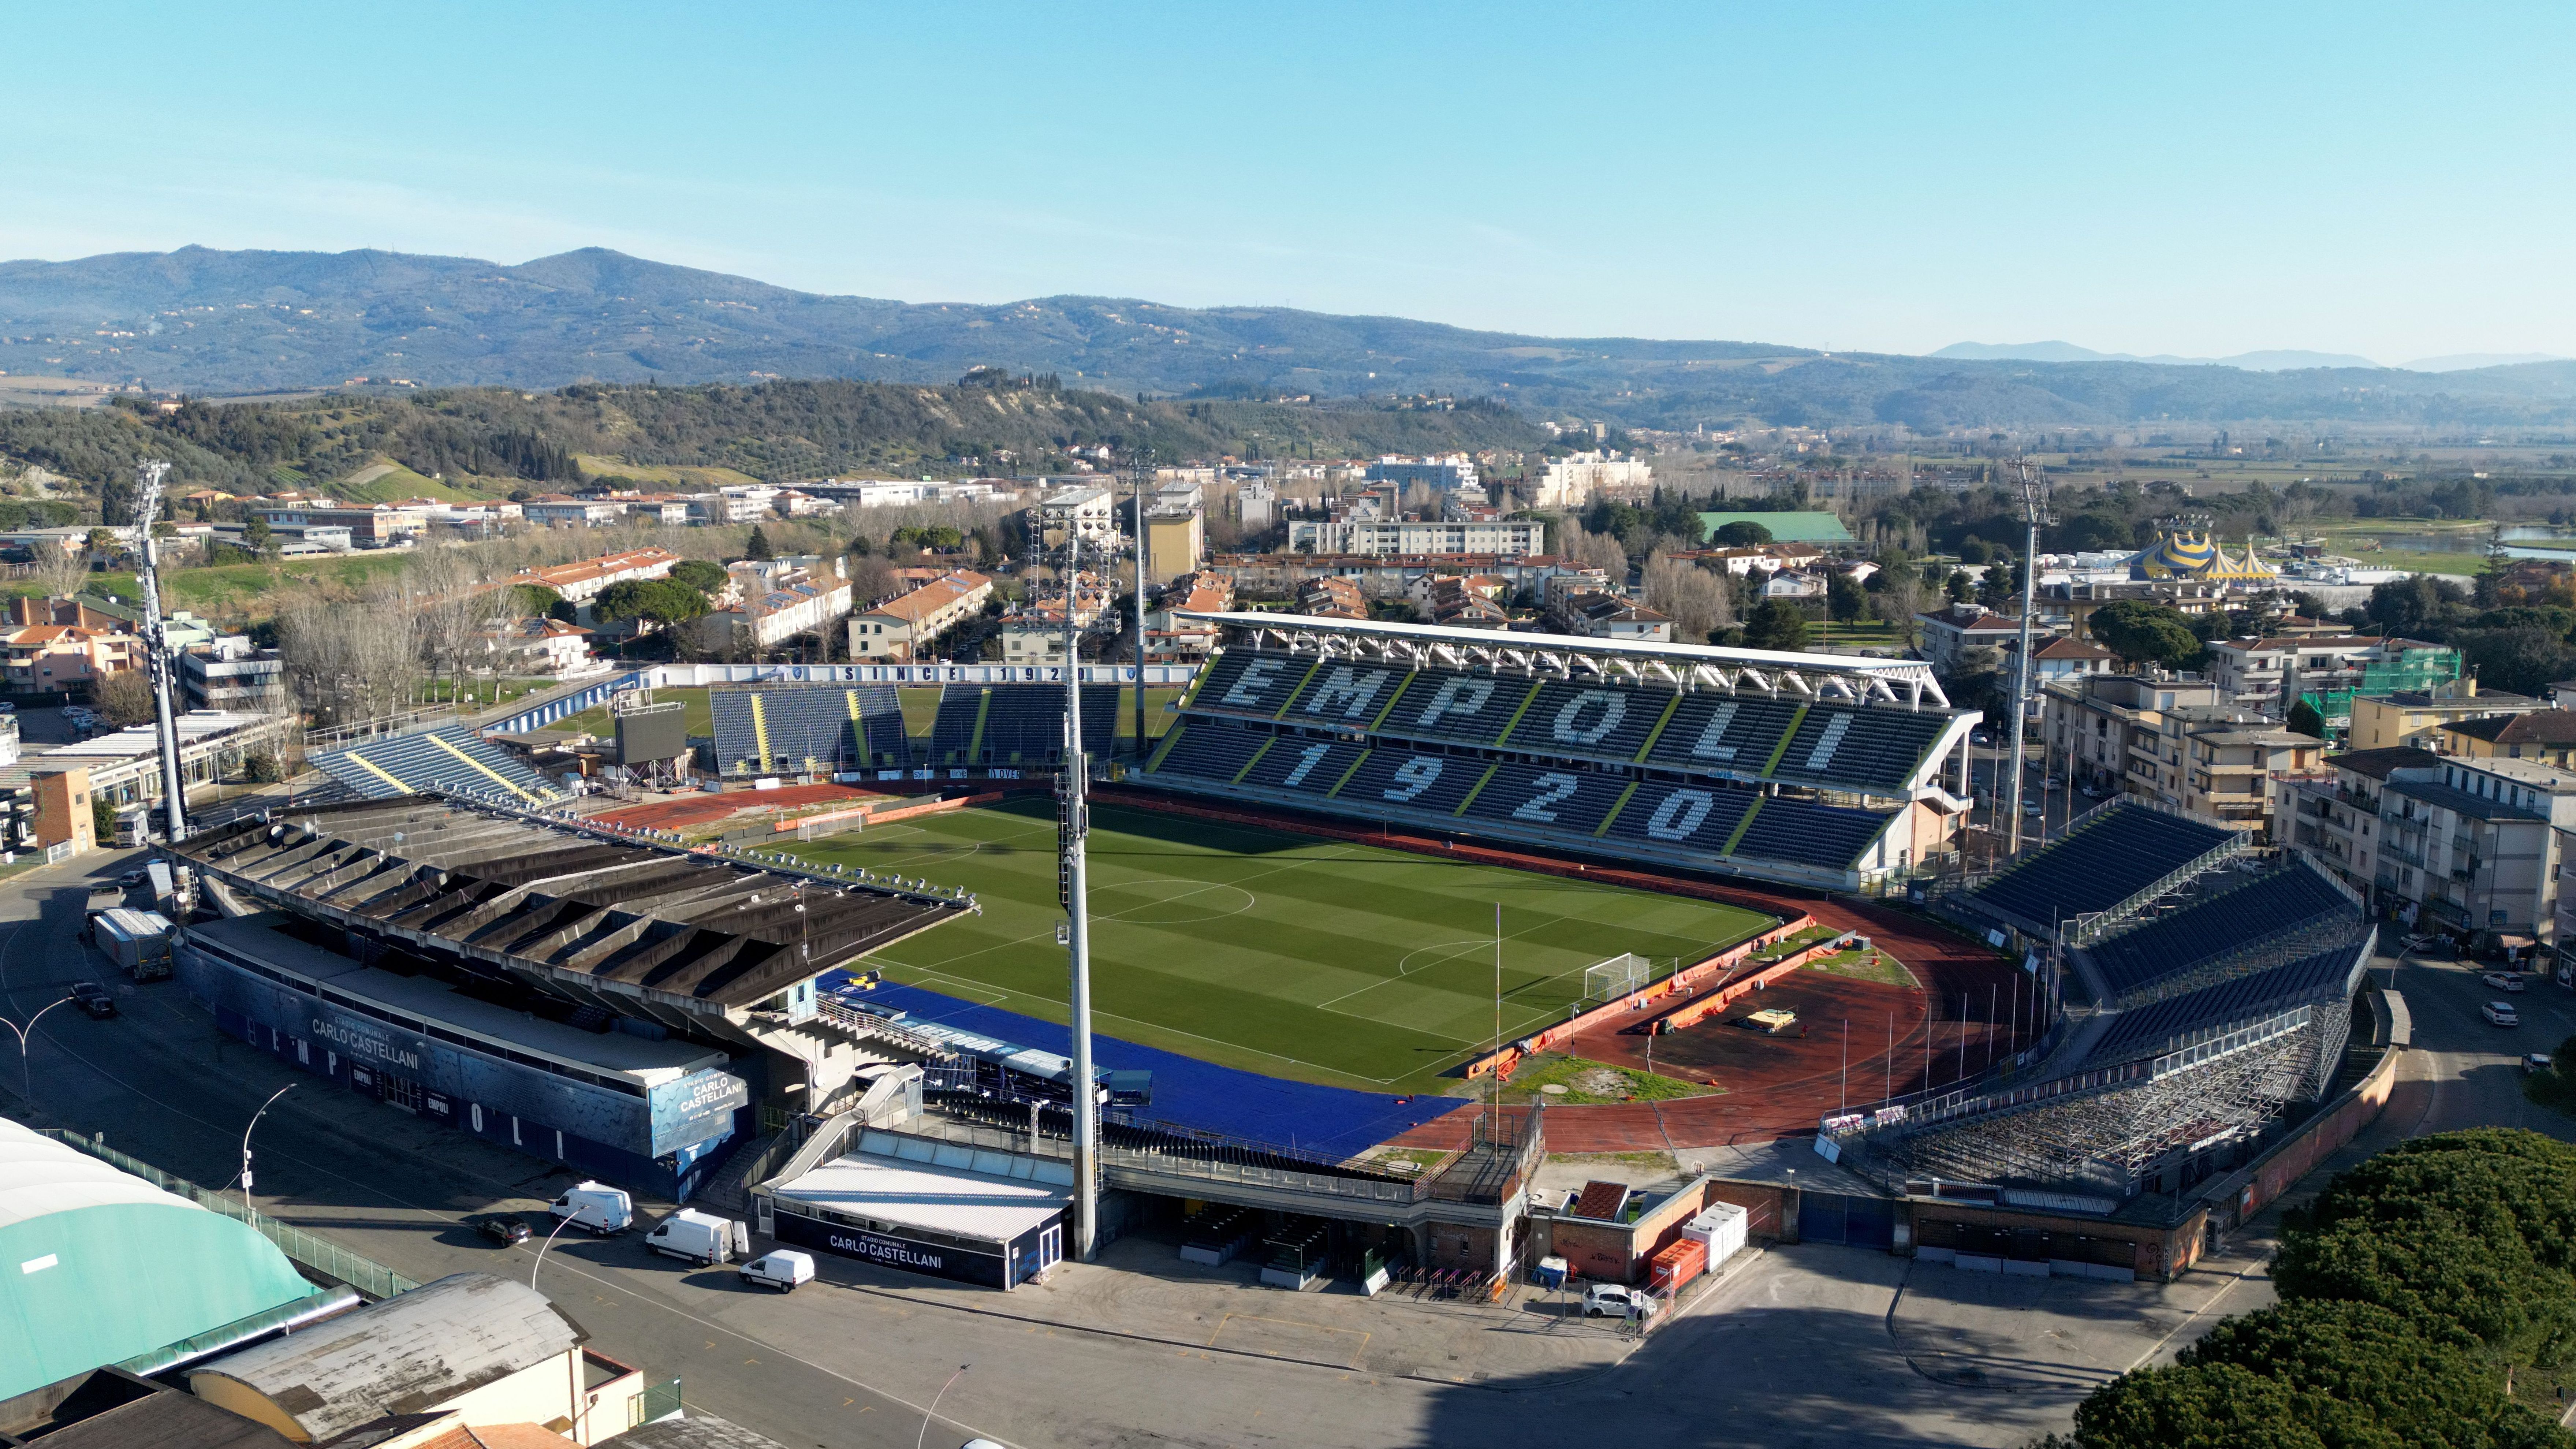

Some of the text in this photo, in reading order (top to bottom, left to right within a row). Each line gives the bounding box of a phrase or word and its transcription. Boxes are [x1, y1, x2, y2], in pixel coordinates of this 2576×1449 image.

[845, 667, 1085, 680] SINCE 1920
[510, 699, 571, 733] EMPOLI
[1221, 658, 1853, 769] EMPOLI
[1709, 768, 1733, 779] AVIS
[1284, 743, 1713, 840] 1920
[335, 1016, 390, 1042] STADIO COMUNALE
[313, 1018, 347, 1044] CARLO
[350, 1033, 418, 1070] CASTELLANI
[354, 1069, 372, 1085] EMPOLI
[683, 1079, 704, 1088] STADIO
[693, 1077, 728, 1097] CARLO
[428, 1097, 448, 1114] EMPOLI
[681, 1082, 742, 1112] CASTELLANI
[830, 1235, 941, 1269] CARLO CASTELLANI
[861, 1235, 906, 1249] STADIO COMUNALE
